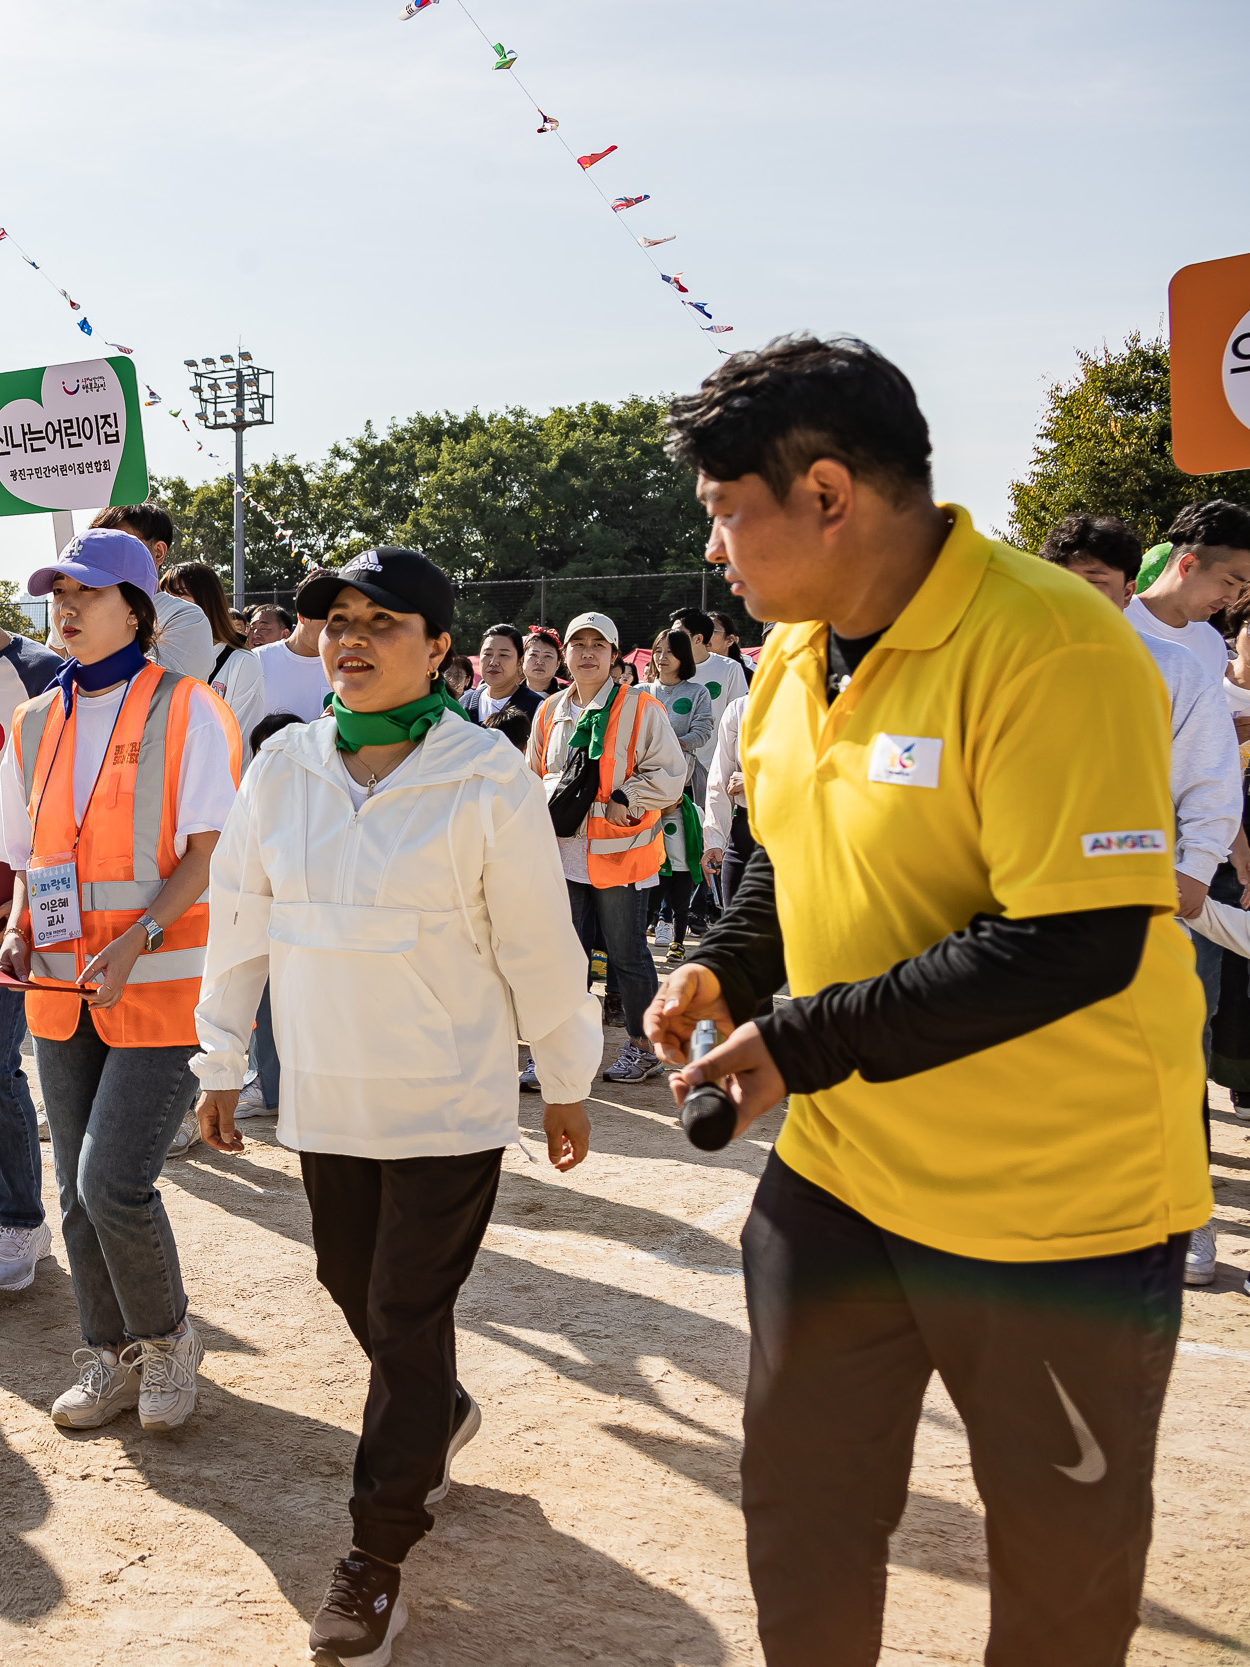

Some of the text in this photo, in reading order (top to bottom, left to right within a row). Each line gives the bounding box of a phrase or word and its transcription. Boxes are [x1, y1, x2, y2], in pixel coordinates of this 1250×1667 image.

[9, 459, 112, 481] 광진구민간어린이집연합회
[1089, 834, 1162, 852] ANGEL
[40, 877, 71, 891] 파랑팀
[40, 897, 69, 912] 이은혜
[46, 914, 65, 927] 교사
